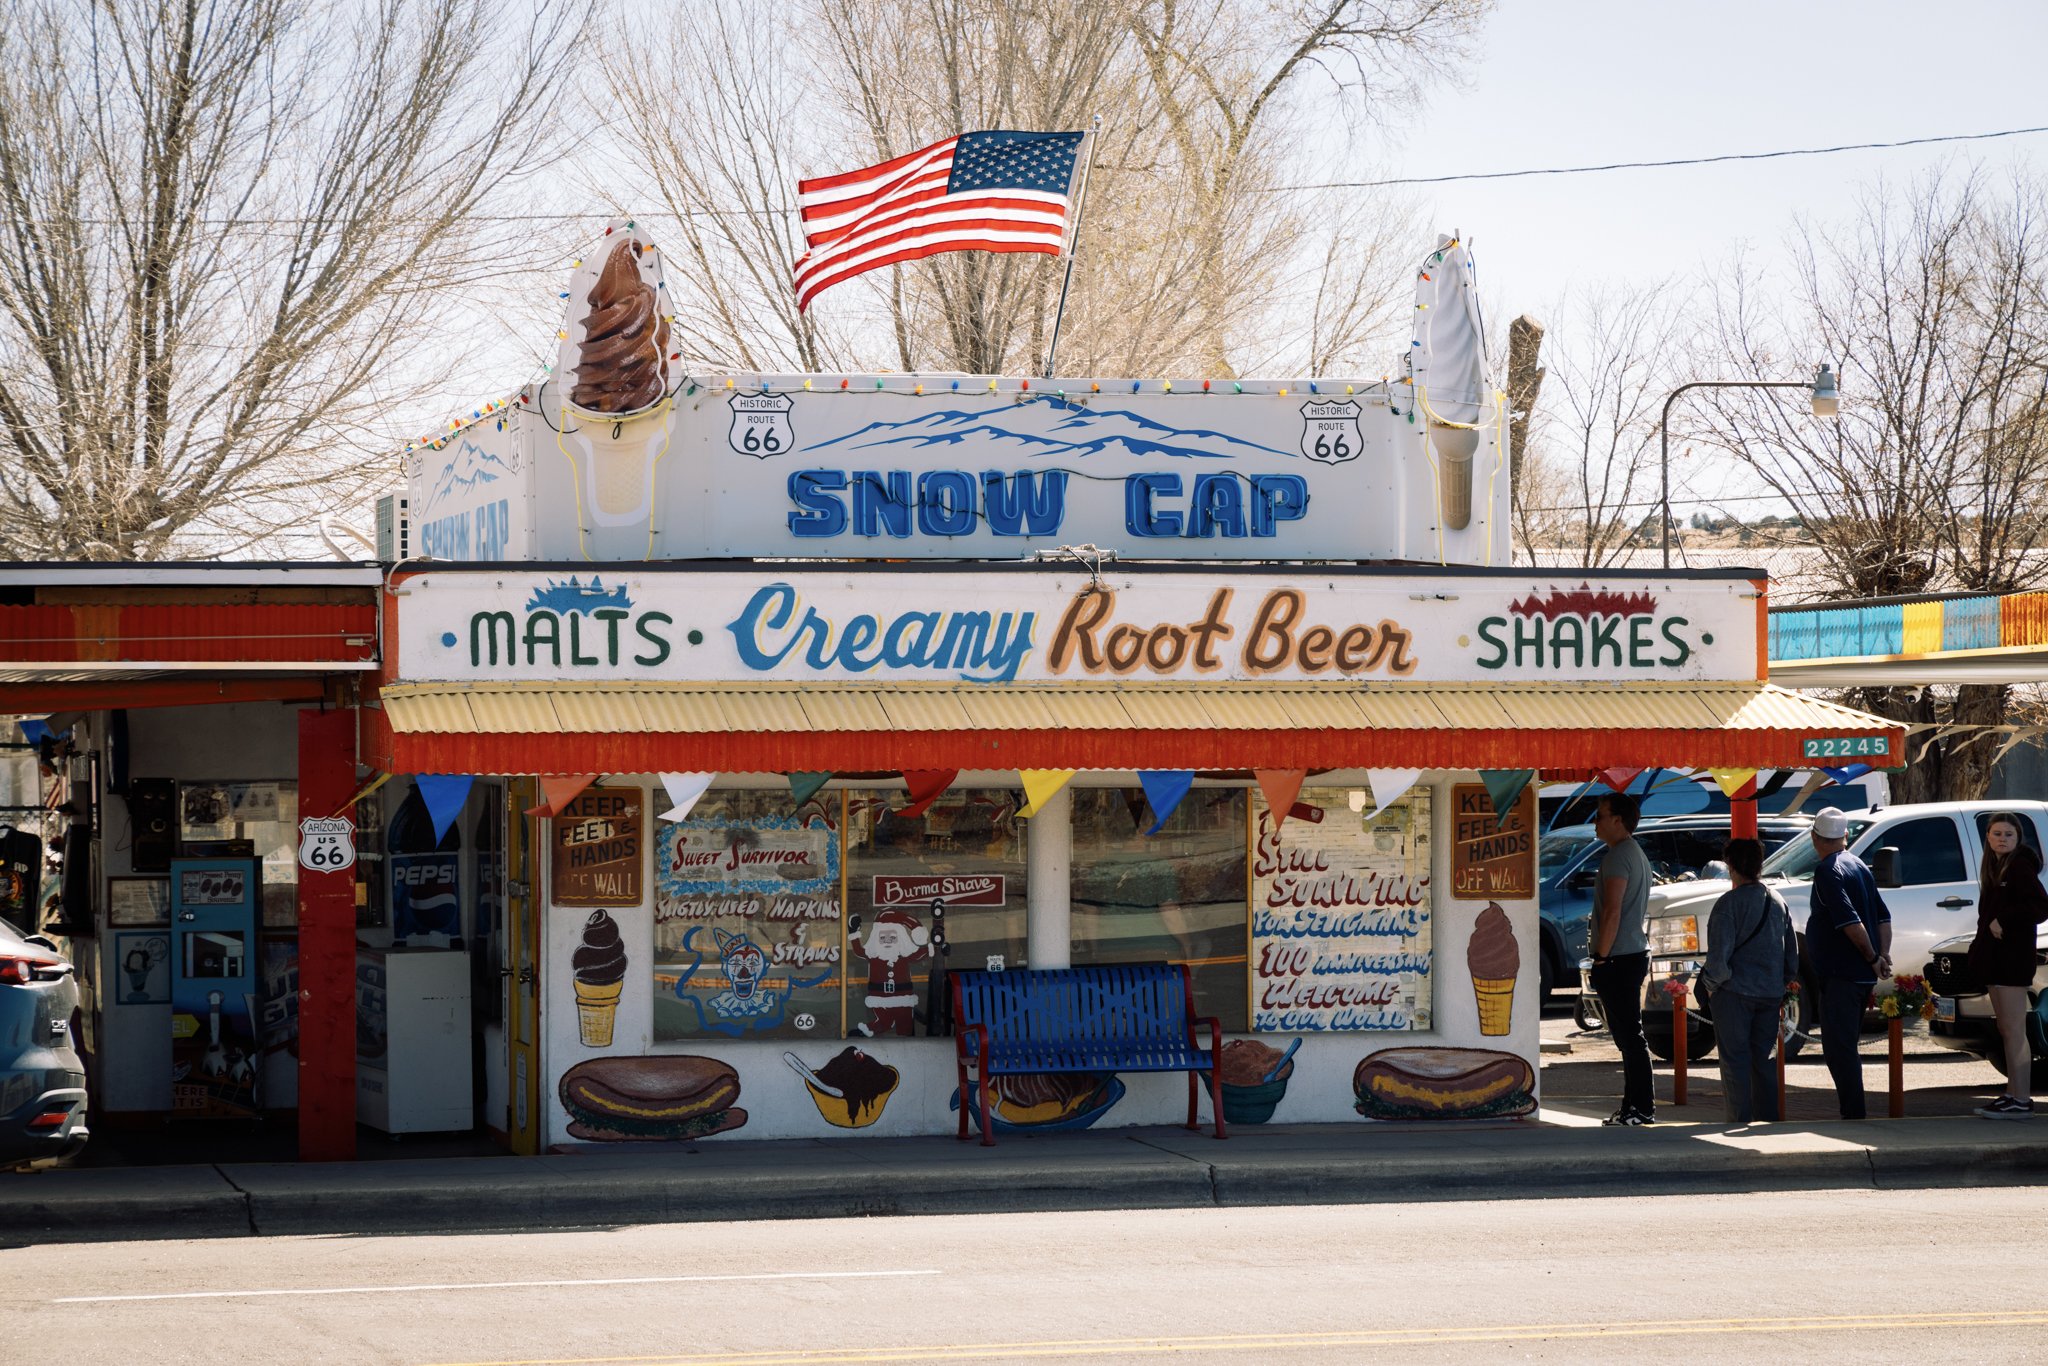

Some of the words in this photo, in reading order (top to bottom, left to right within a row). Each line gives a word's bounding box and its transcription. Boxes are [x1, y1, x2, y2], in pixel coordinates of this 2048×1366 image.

[740, 399, 782, 408] HISTORIC
[1311, 406, 1351, 416] HISTORIC
[747, 415, 776, 424] ROUTE
[1318, 422, 1345, 431] ROUTE
[743, 426, 780, 452] 66
[1314, 433, 1350, 458] 66
[787, 469, 1070, 538] SNOW
[1124, 472, 1309, 538] CAP
[475, 499, 510, 561] CAP
[470, 609, 674, 666] MALTS
[725, 582, 1036, 683] Creamy
[1046, 583, 1234, 675] Root
[1241, 585, 1418, 675] Beer
[1476, 616, 1690, 669] SHAKES
[1807, 738, 1885, 757] 22245
[1462, 793, 1521, 813] KE
[307, 823, 347, 833] ARIZONA
[317, 836, 337, 844] US
[560, 819, 615, 847] FEET
[311, 846, 344, 866] 66
[571, 838, 637, 868] HANDS
[1469, 832, 1531, 863] HANDS
[394, 864, 456, 887] PEPSI
[594, 872, 636, 896] WALL
[1455, 865, 1485, 890] OFF
[883, 880, 940, 904] Burma
[942, 877, 996, 895] Shave
[767, 899, 841, 922] NAPKINS
[773, 941, 840, 969] STRAWS
[1259, 943, 1313, 978] 100
[1261, 978, 1400, 1010] WELCOME
[796, 1016, 813, 1028] 66
